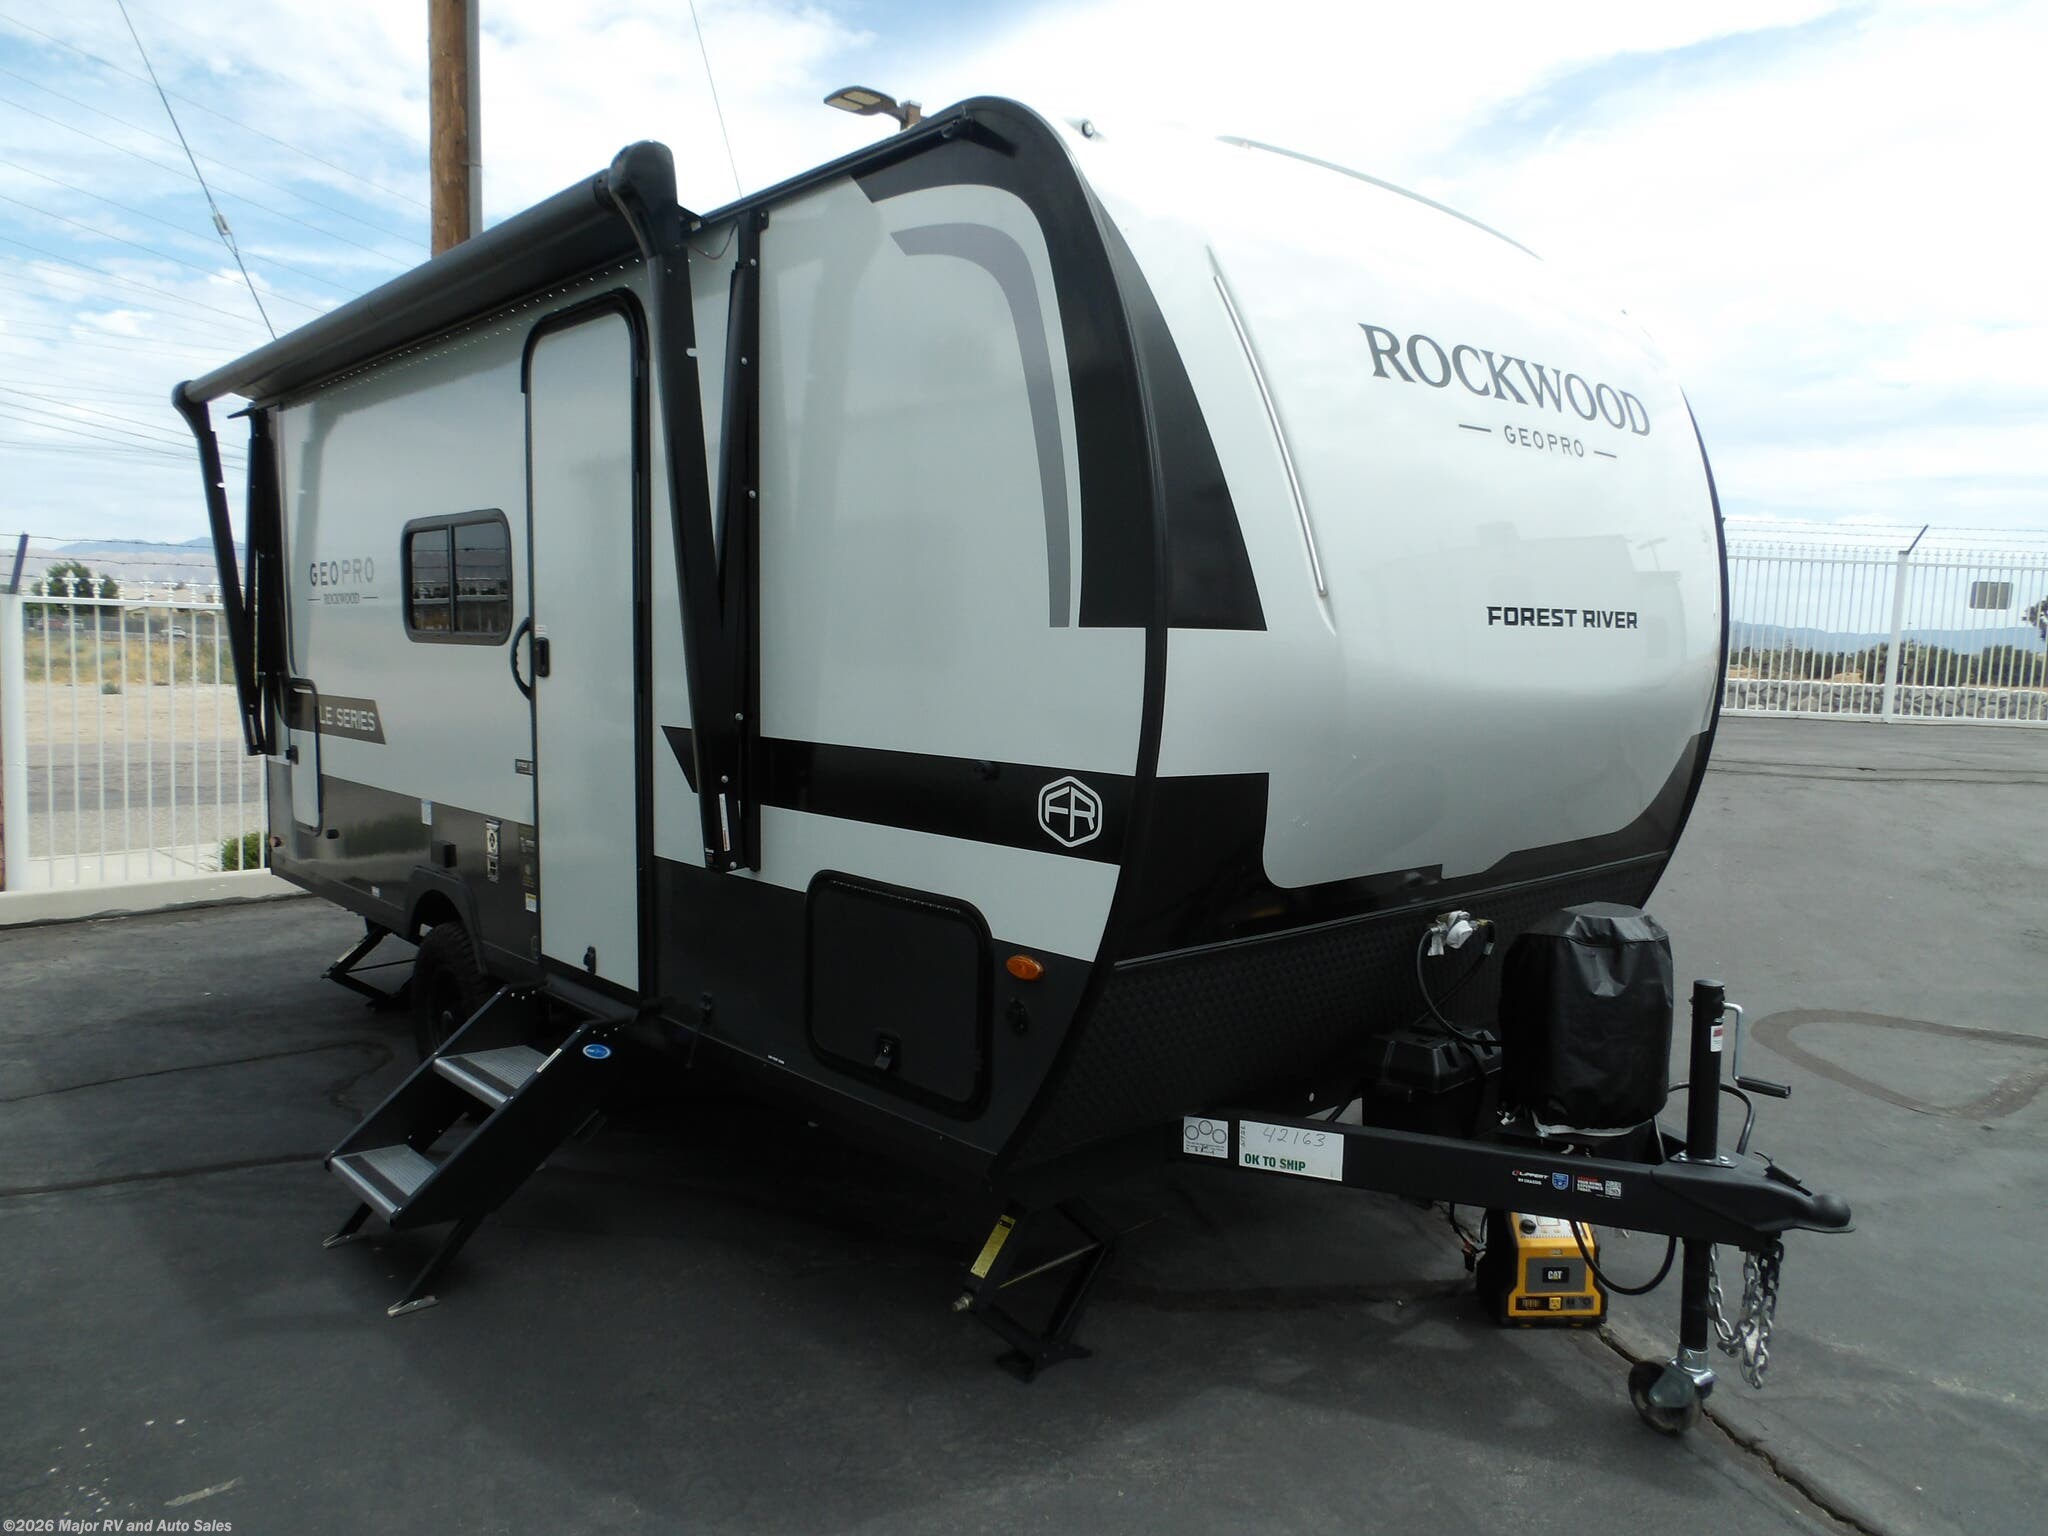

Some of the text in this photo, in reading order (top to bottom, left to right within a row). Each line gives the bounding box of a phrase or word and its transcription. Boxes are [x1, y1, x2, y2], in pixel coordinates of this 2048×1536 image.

[1358, 322, 1650, 436] ROCKWOOD
[1504, 424, 1585, 458] GEOPRO
[310, 557, 374, 586] GEOPRO
[1486, 606, 1638, 629] FOREST RIVER
[319, 704, 376, 731] LE SERIES
[1263, 1126, 1327, 1147] 42163
[1244, 1153, 1306, 1172] OK TO SHIP
[1547, 1270, 1563, 1280] CAT
